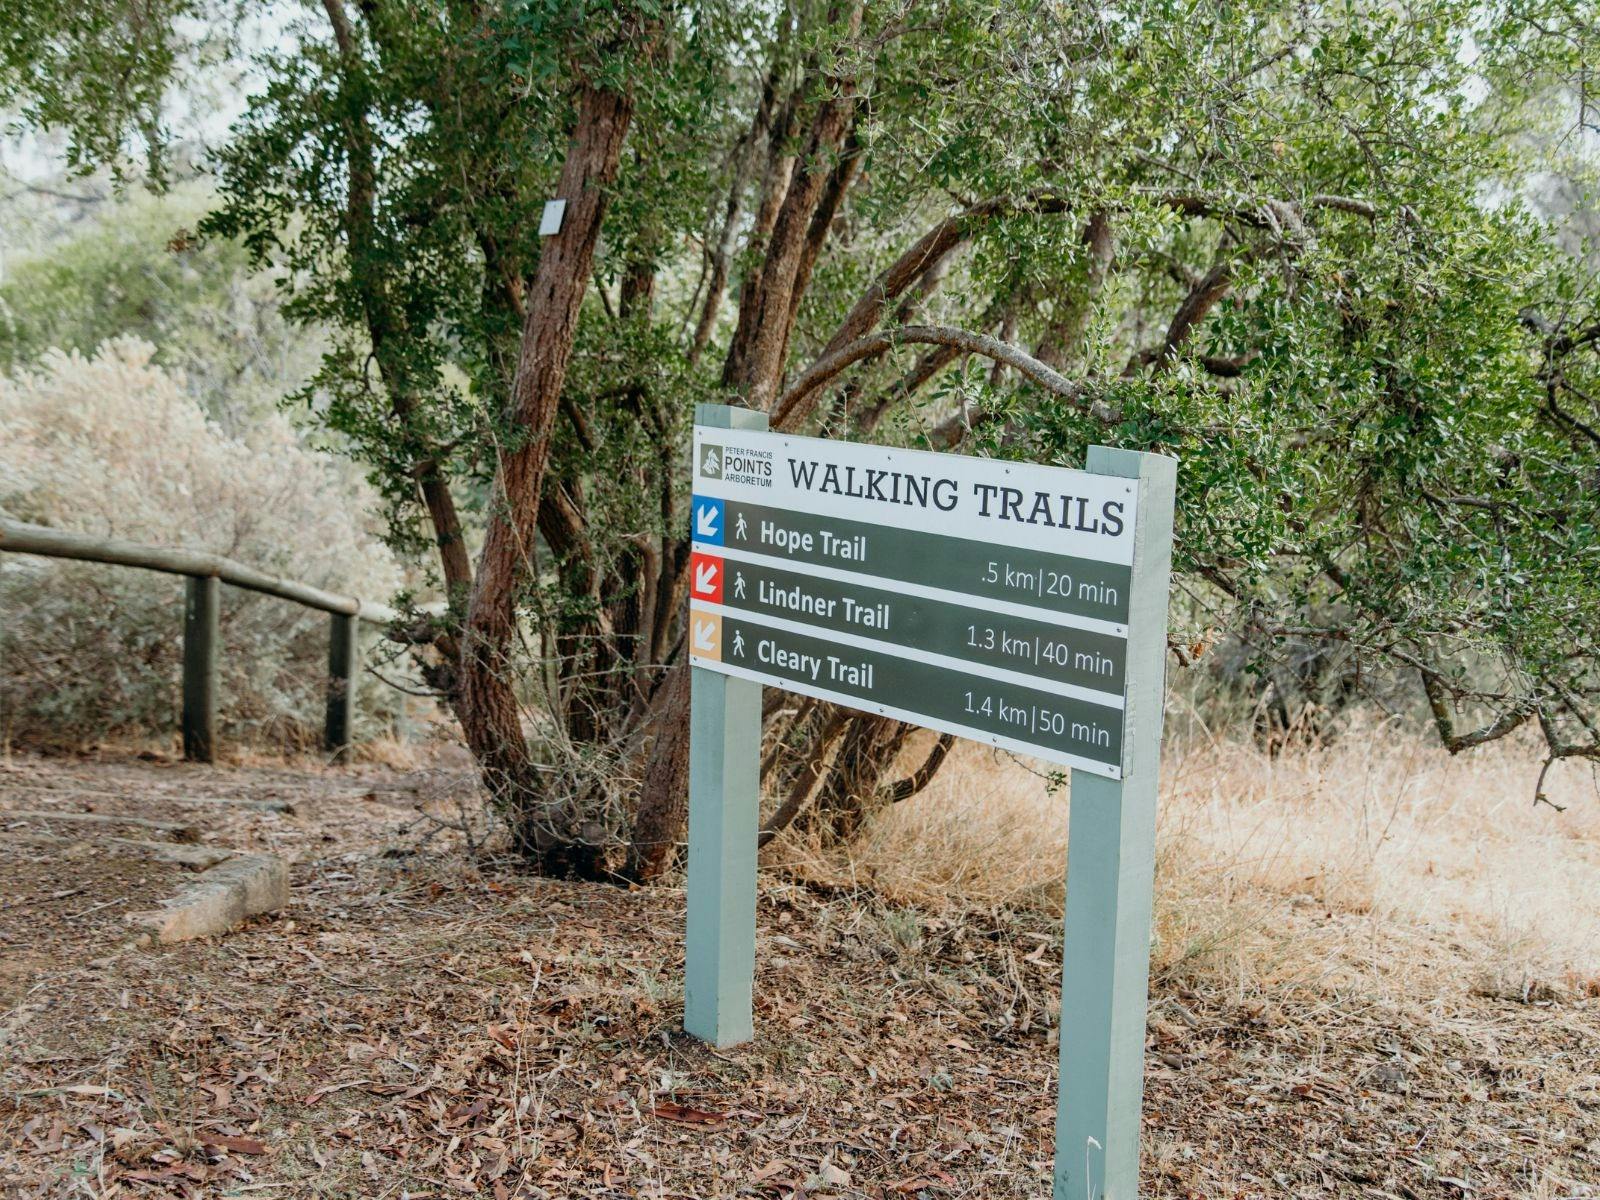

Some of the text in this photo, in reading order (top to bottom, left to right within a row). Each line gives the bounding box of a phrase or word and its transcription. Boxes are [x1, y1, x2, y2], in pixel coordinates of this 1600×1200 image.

[725, 446, 773, 459] PETER FRANCIS
[725, 456, 772, 476] POINTS
[725, 473, 772, 487] ARBORETUM
[788, 458, 1124, 537] WALKING TRAILS
[761, 520, 866, 561] Hope Trail
[759, 580, 889, 630] Lindner Trail
[1079, 581, 1117, 606] min
[758, 639, 873, 689] Cleary Trail
[967, 625, 995, 650] 1.3
[1075, 651, 1113, 676] min
[964, 691, 993, 717] 1.4
[1071, 722, 1109, 747] min
